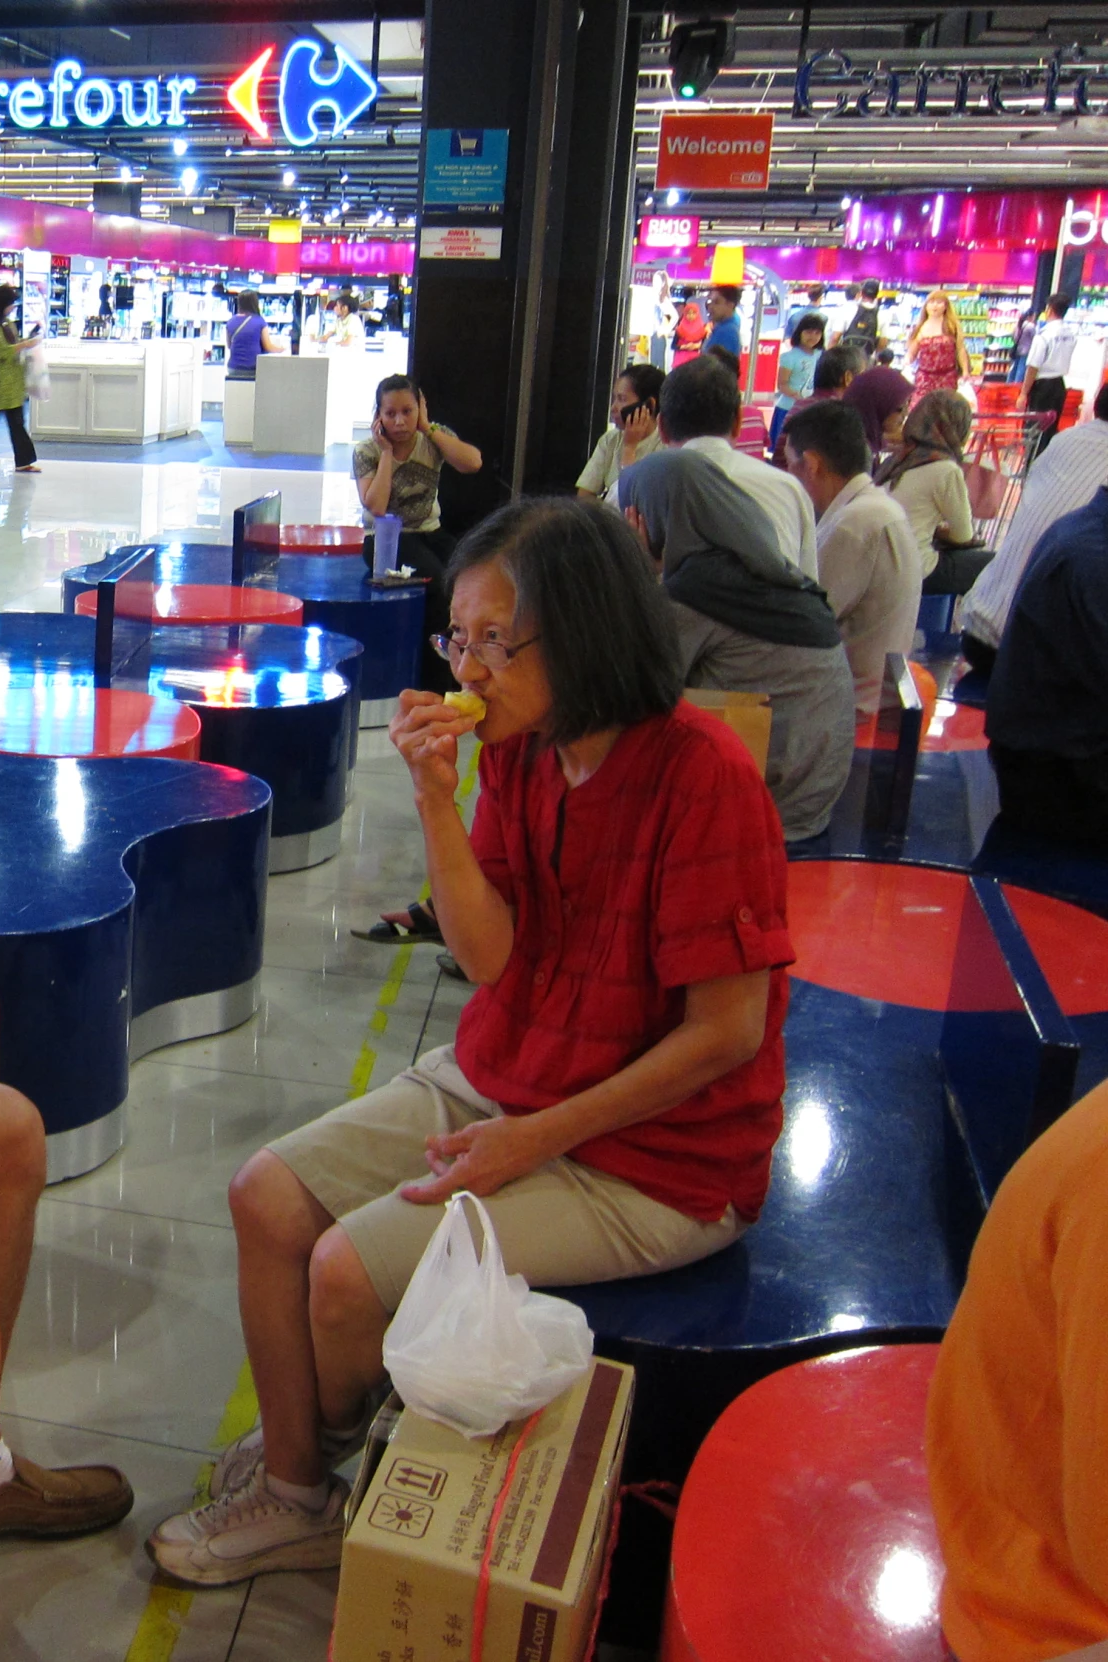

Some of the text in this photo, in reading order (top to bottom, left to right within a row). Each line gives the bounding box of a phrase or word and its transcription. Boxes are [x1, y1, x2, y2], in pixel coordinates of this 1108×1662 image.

[666, 136, 766, 155] Welcome
[648, 218, 691, 234] RM10
[1064, 198, 1108, 246] b
